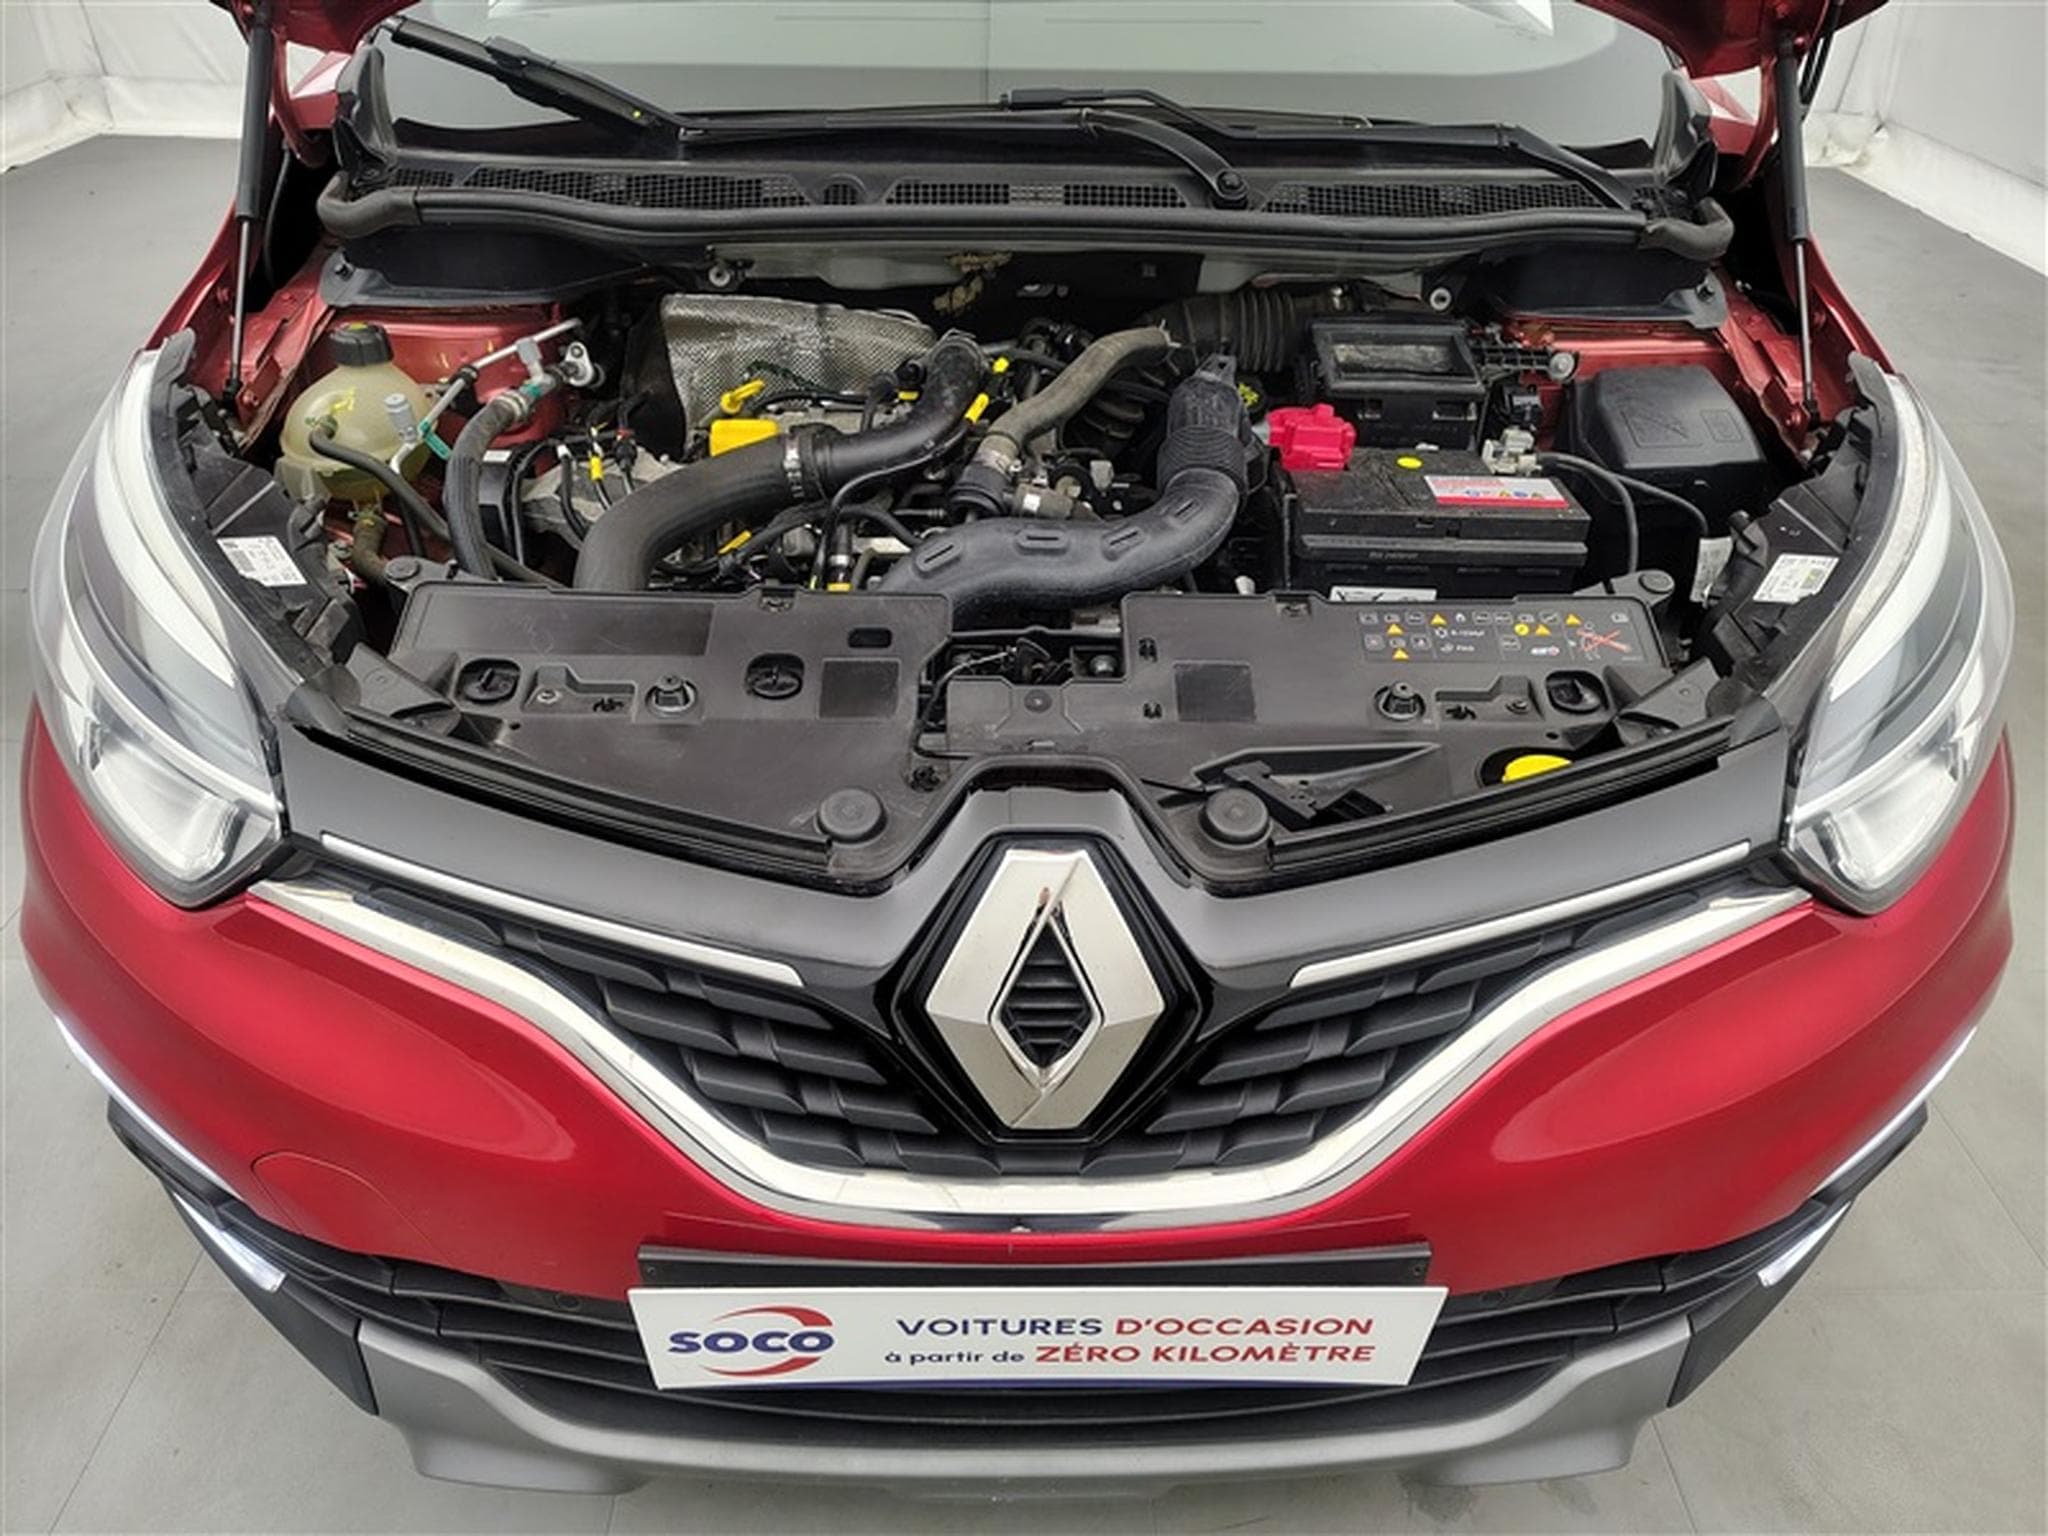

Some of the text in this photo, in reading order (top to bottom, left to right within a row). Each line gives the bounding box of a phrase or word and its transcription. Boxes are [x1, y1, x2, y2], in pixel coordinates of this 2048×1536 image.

[896, 1317, 1374, 1336] VOITURES D'OCCASION
[668, 1330, 834, 1354] SOCO
[884, 1341, 1376, 1366] à partir de ZÉRO KILOMÈTRE
